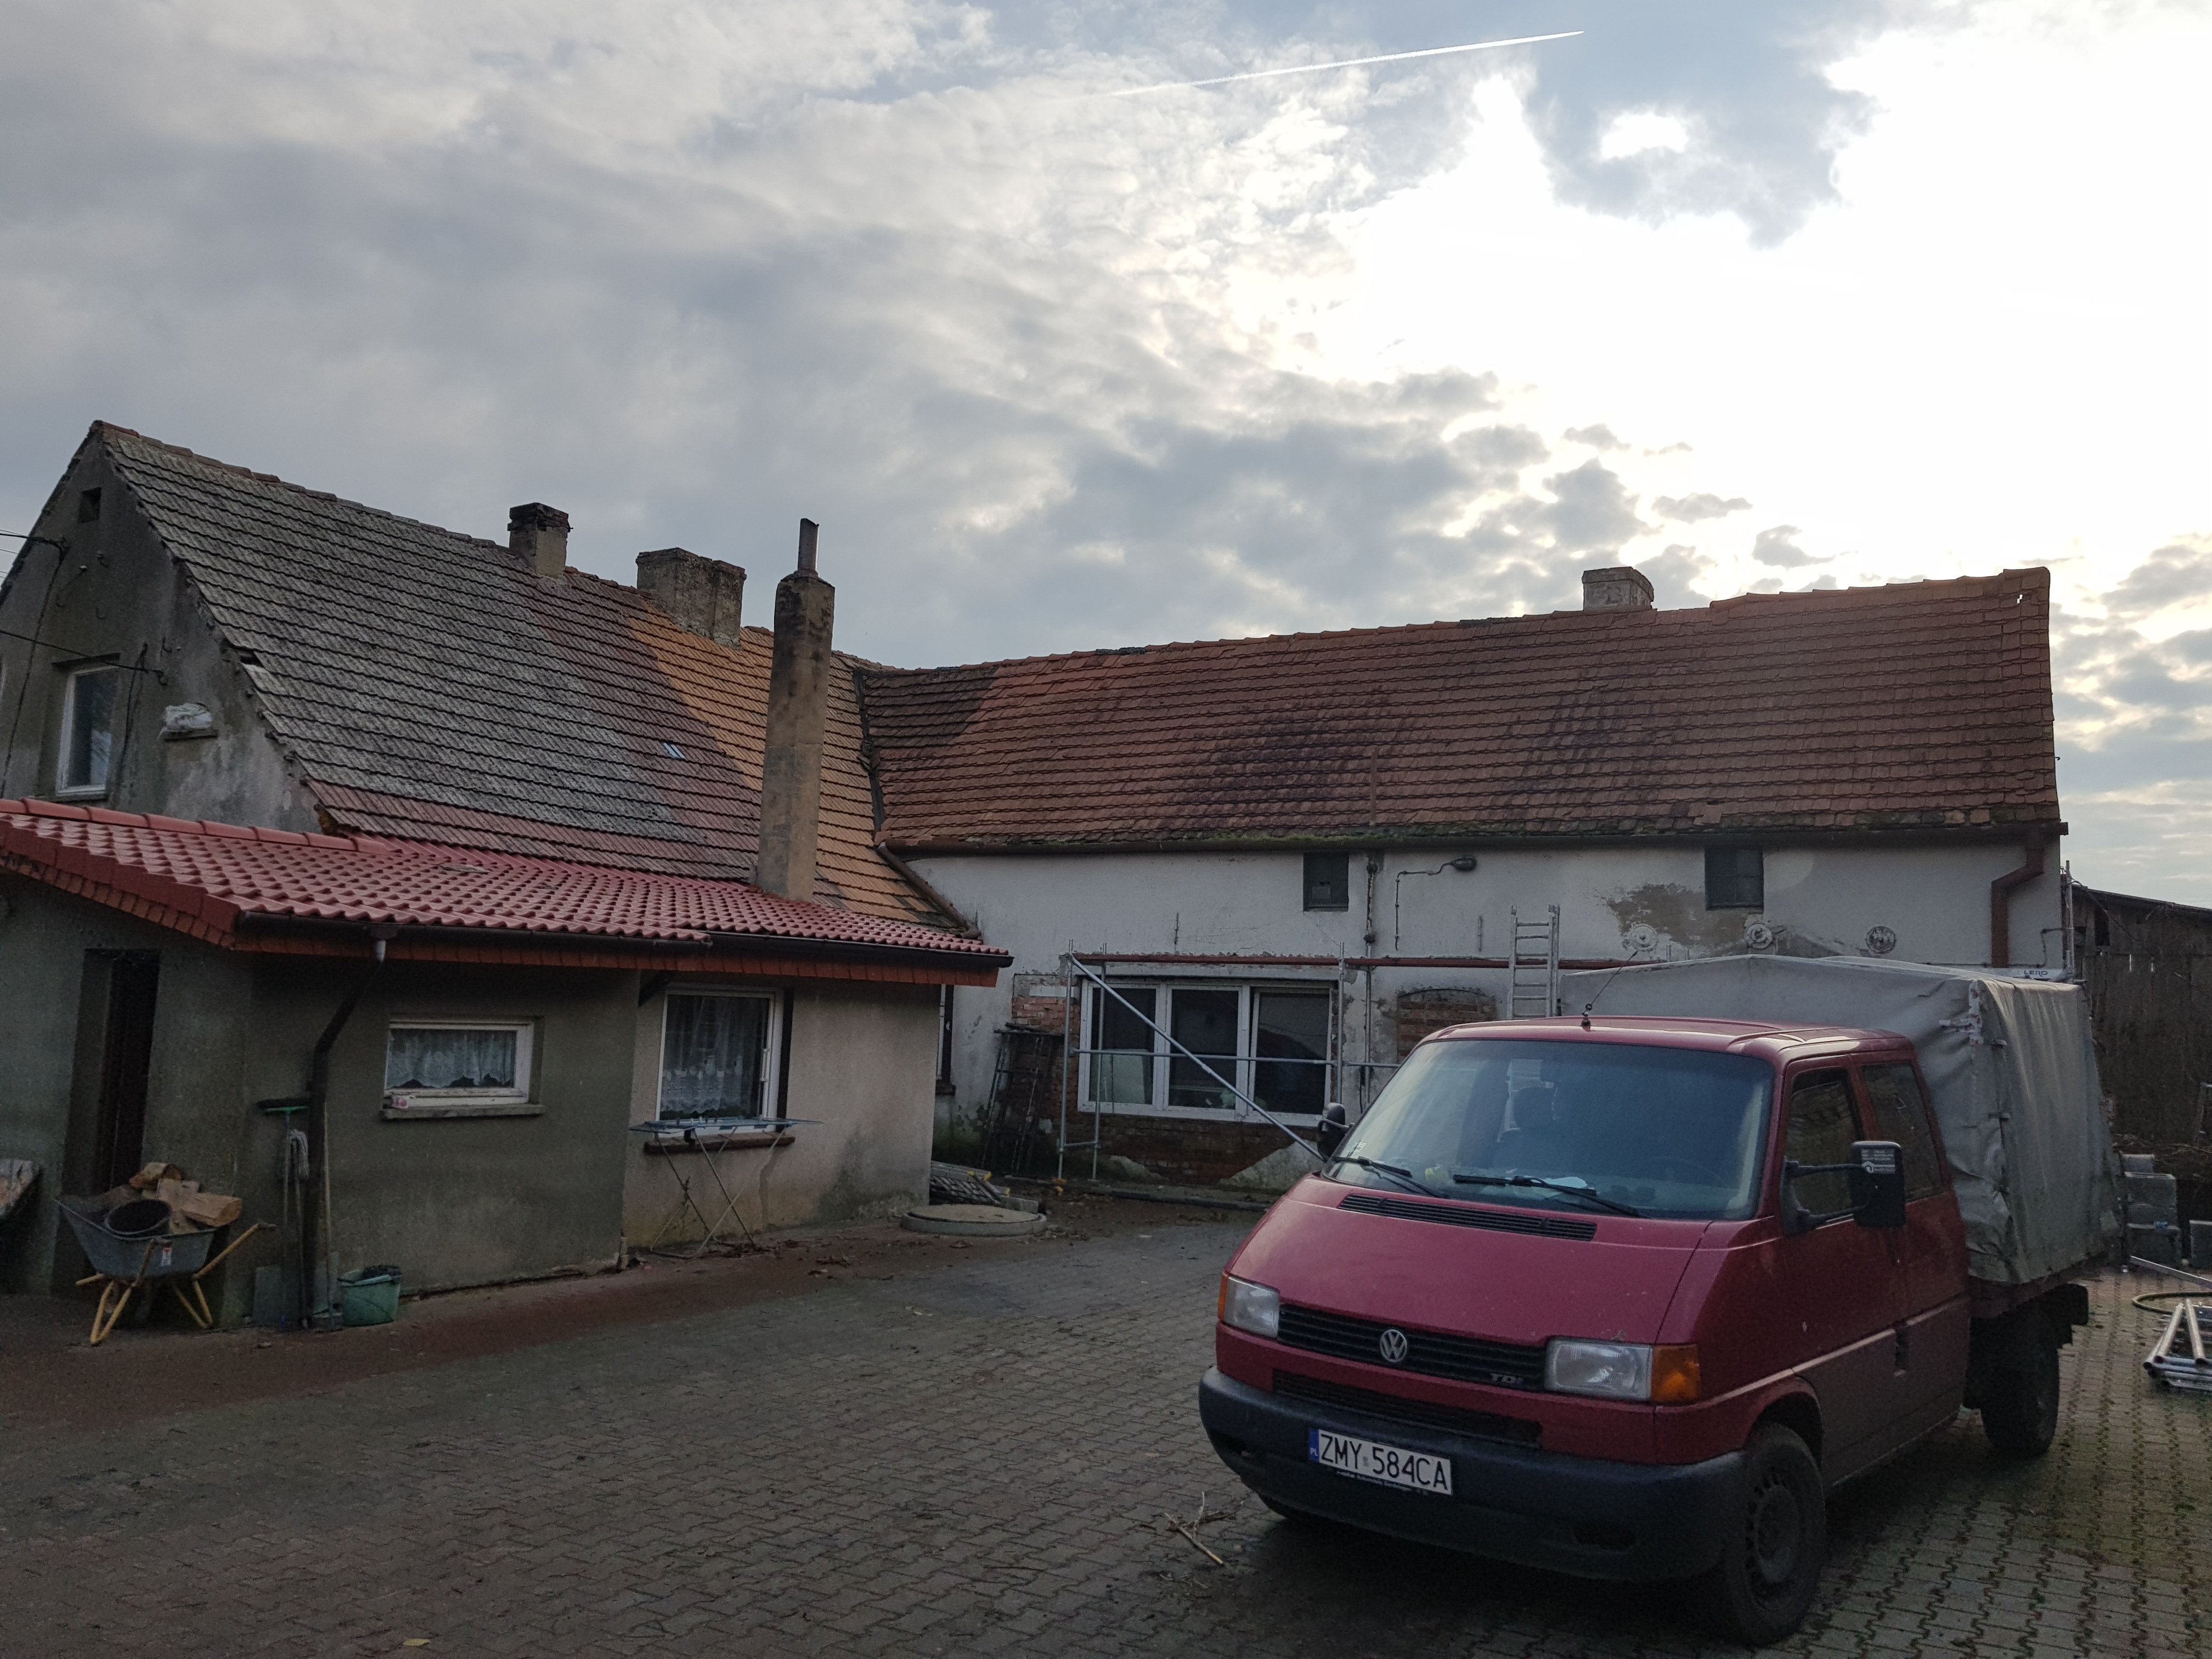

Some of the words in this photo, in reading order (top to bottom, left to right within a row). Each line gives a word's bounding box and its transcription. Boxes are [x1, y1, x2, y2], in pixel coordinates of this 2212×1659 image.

[1380, 1329, 1407, 1363] VW
[1310, 1448, 1318, 1456] PL
[1321, 1434, 1362, 1469] ZMY
[1372, 1446, 1448, 1490] 584CA
